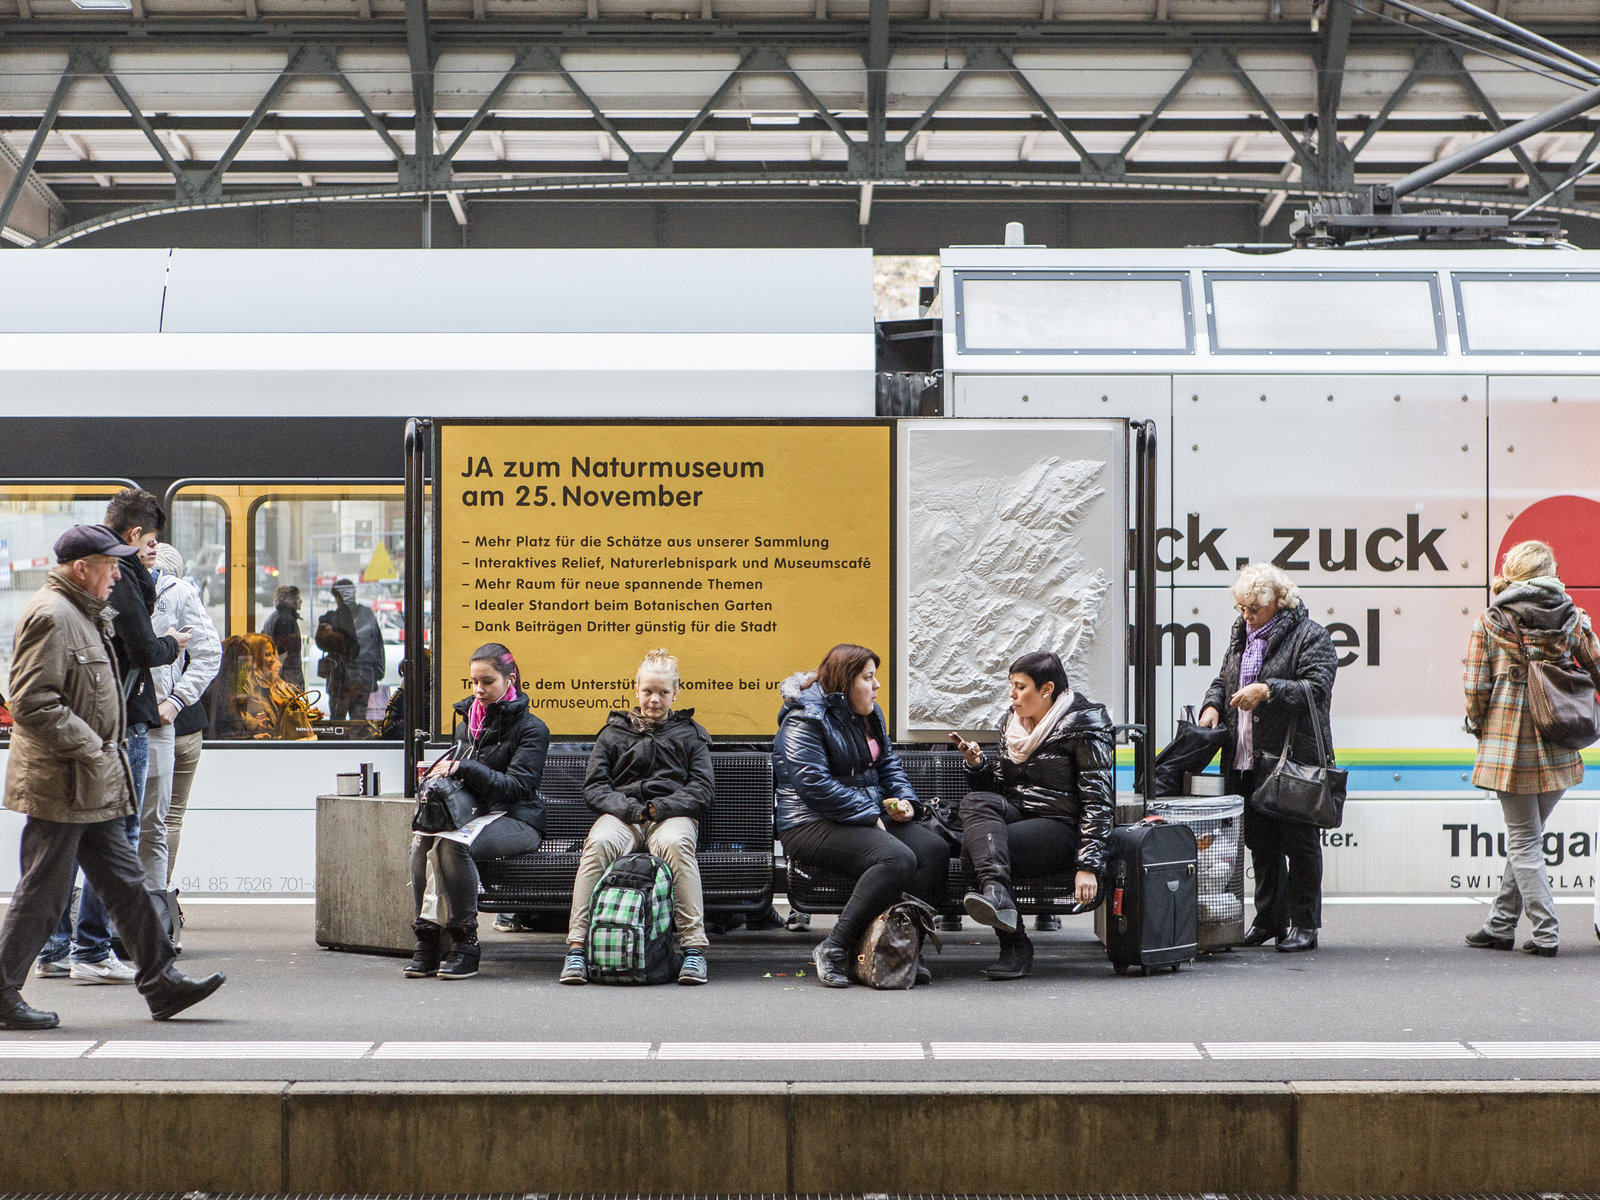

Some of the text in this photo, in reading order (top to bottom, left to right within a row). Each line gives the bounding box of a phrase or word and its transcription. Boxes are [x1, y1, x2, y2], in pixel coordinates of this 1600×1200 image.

[460, 455, 765, 479] JA zum Naturmuseum
[461, 483, 704, 508] am 25. November
[474, 535, 512, 548] Mehr
[516, 535, 551, 548] Platz
[555, 535, 576, 548] für
[579, 535, 602, 548] die
[606, 535, 662, 548] Schätze
[666, 538, 692, 548] aus
[696, 538, 750, 548] unserer
[754, 535, 830, 551] Sammlung
[1271, 513, 1449, 572] zuck
[474, 556, 557, 569] Interaktives
[561, 556, 605, 571] Relief,
[610, 556, 738, 572] Naturerlebnispark
[742, 556, 769, 569] und
[773, 556, 872, 570] Museumscafé
[474, 577, 512, 590] Mehr
[516, 578, 556, 591] Raum
[560, 577, 581, 590] für
[585, 580, 620, 591] neue
[624, 577, 703, 593] spannende
[707, 577, 763, 591] Themen
[474, 598, 525, 611] Idealer
[528, 598, 590, 612] Standort
[594, 598, 629, 612] beim
[634, 599, 720, 612] Botanischen
[724, 599, 773, 612] Garten
[474, 619, 511, 633] Dank
[515, 620, 582, 635] Beiträgen
[587, 620, 631, 633] Dritter
[634, 620, 686, 636] günstig
[690, 620, 711, 633] für
[714, 620, 736, 633] die
[740, 620, 778, 633] Stadt
[535, 677, 566, 691] dem
[738, 677, 760, 691] bei
[528, 695, 631, 709] urmuseum.ch
[1319, 828, 1358, 847] ter.
[1442, 823, 1598, 867] Thuga
[181, 876, 200, 891] 94
[208, 876, 229, 891] 85
[235, 876, 273, 891] 7526
